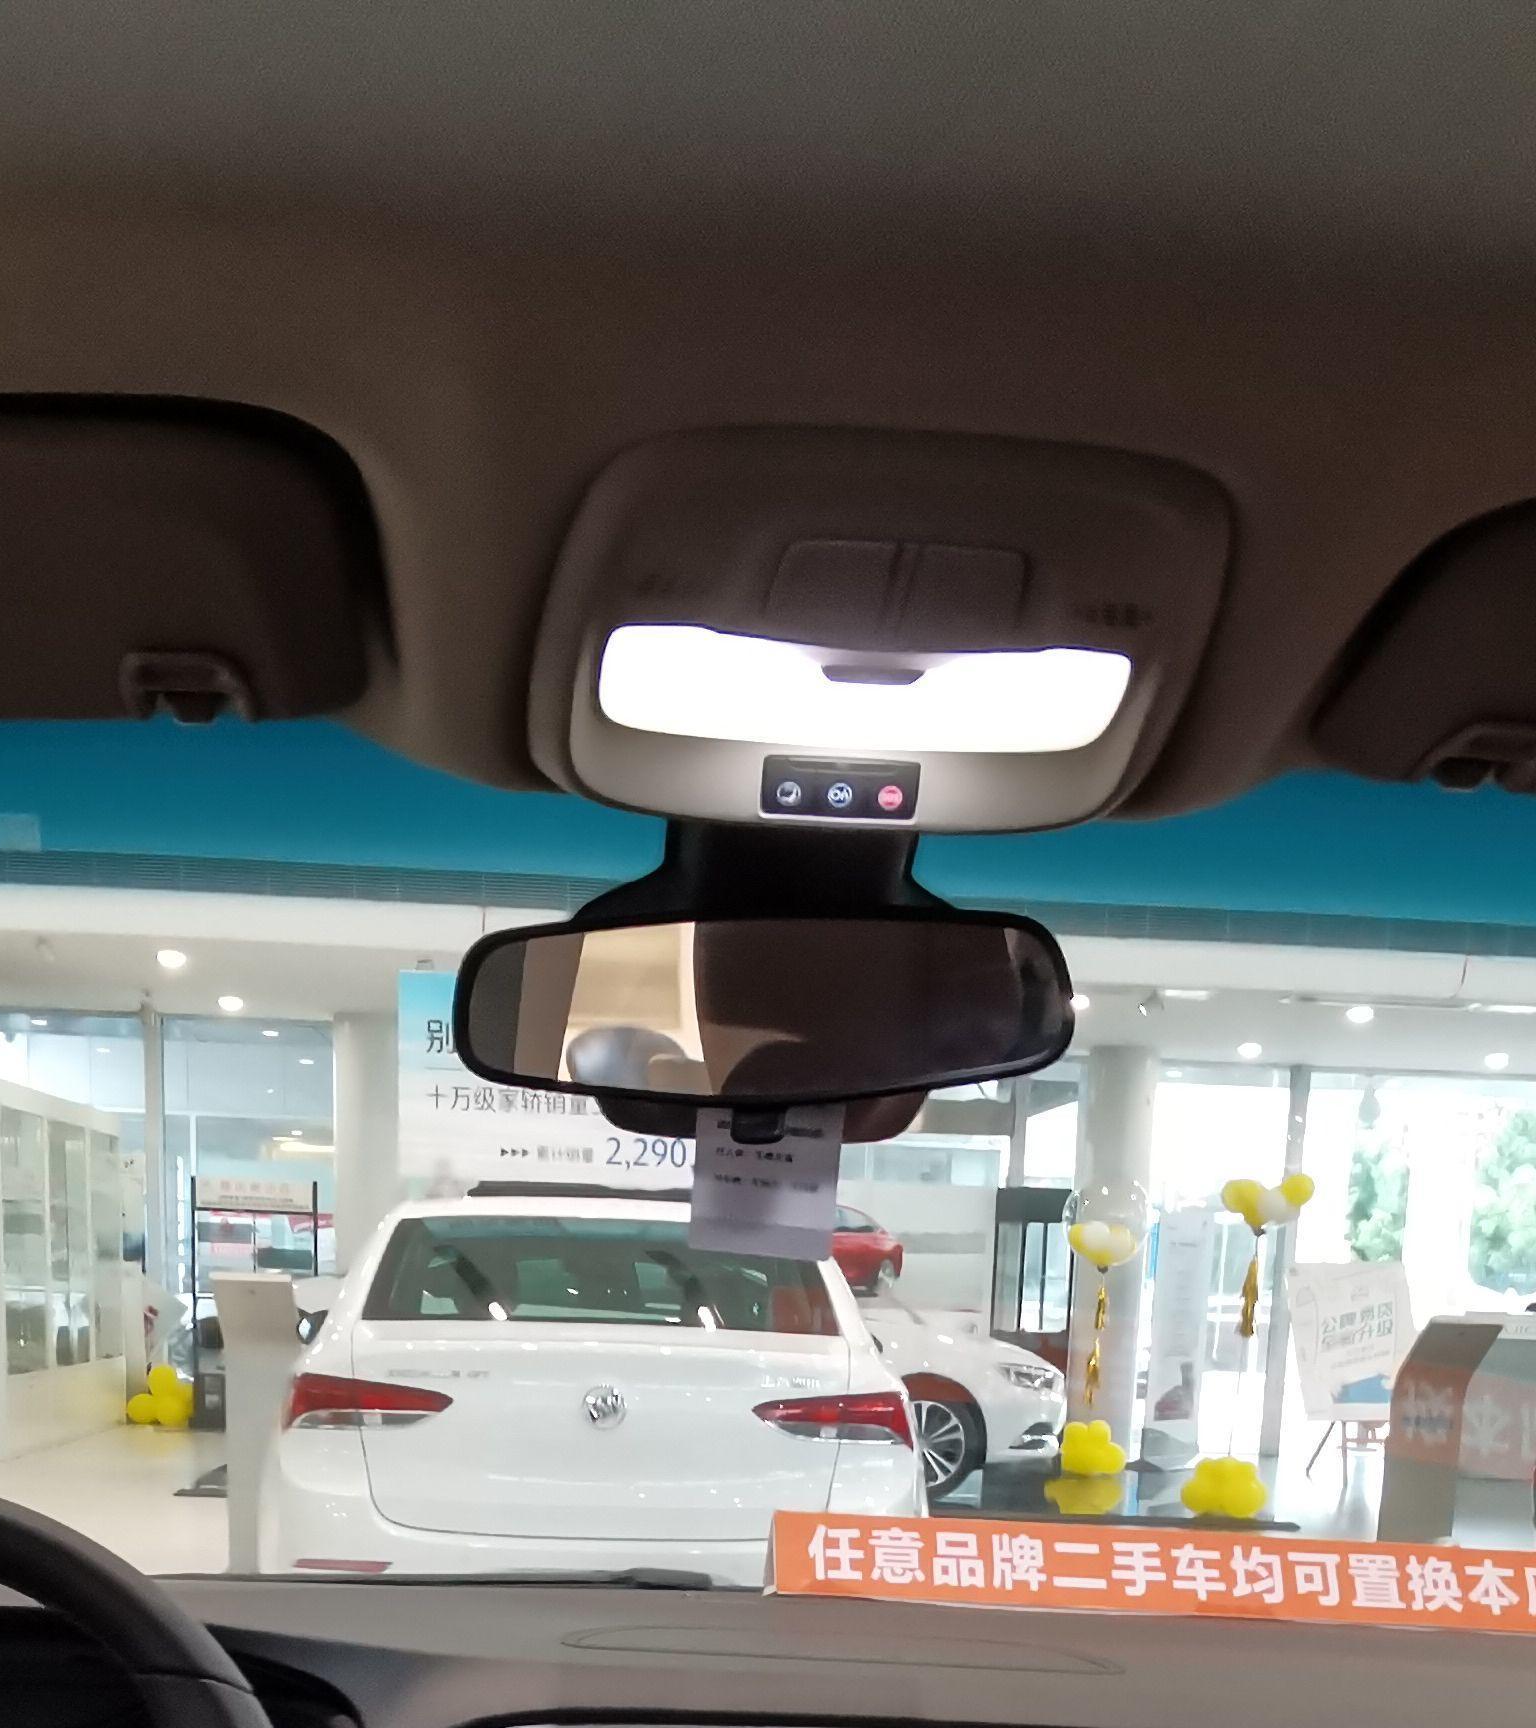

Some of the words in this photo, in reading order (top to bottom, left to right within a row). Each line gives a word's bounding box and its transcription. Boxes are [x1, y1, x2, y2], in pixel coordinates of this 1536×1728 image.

[426, 1084, 599, 1115] 十万级家轿销量
[605, 1137, 697, 1170] 2,290
